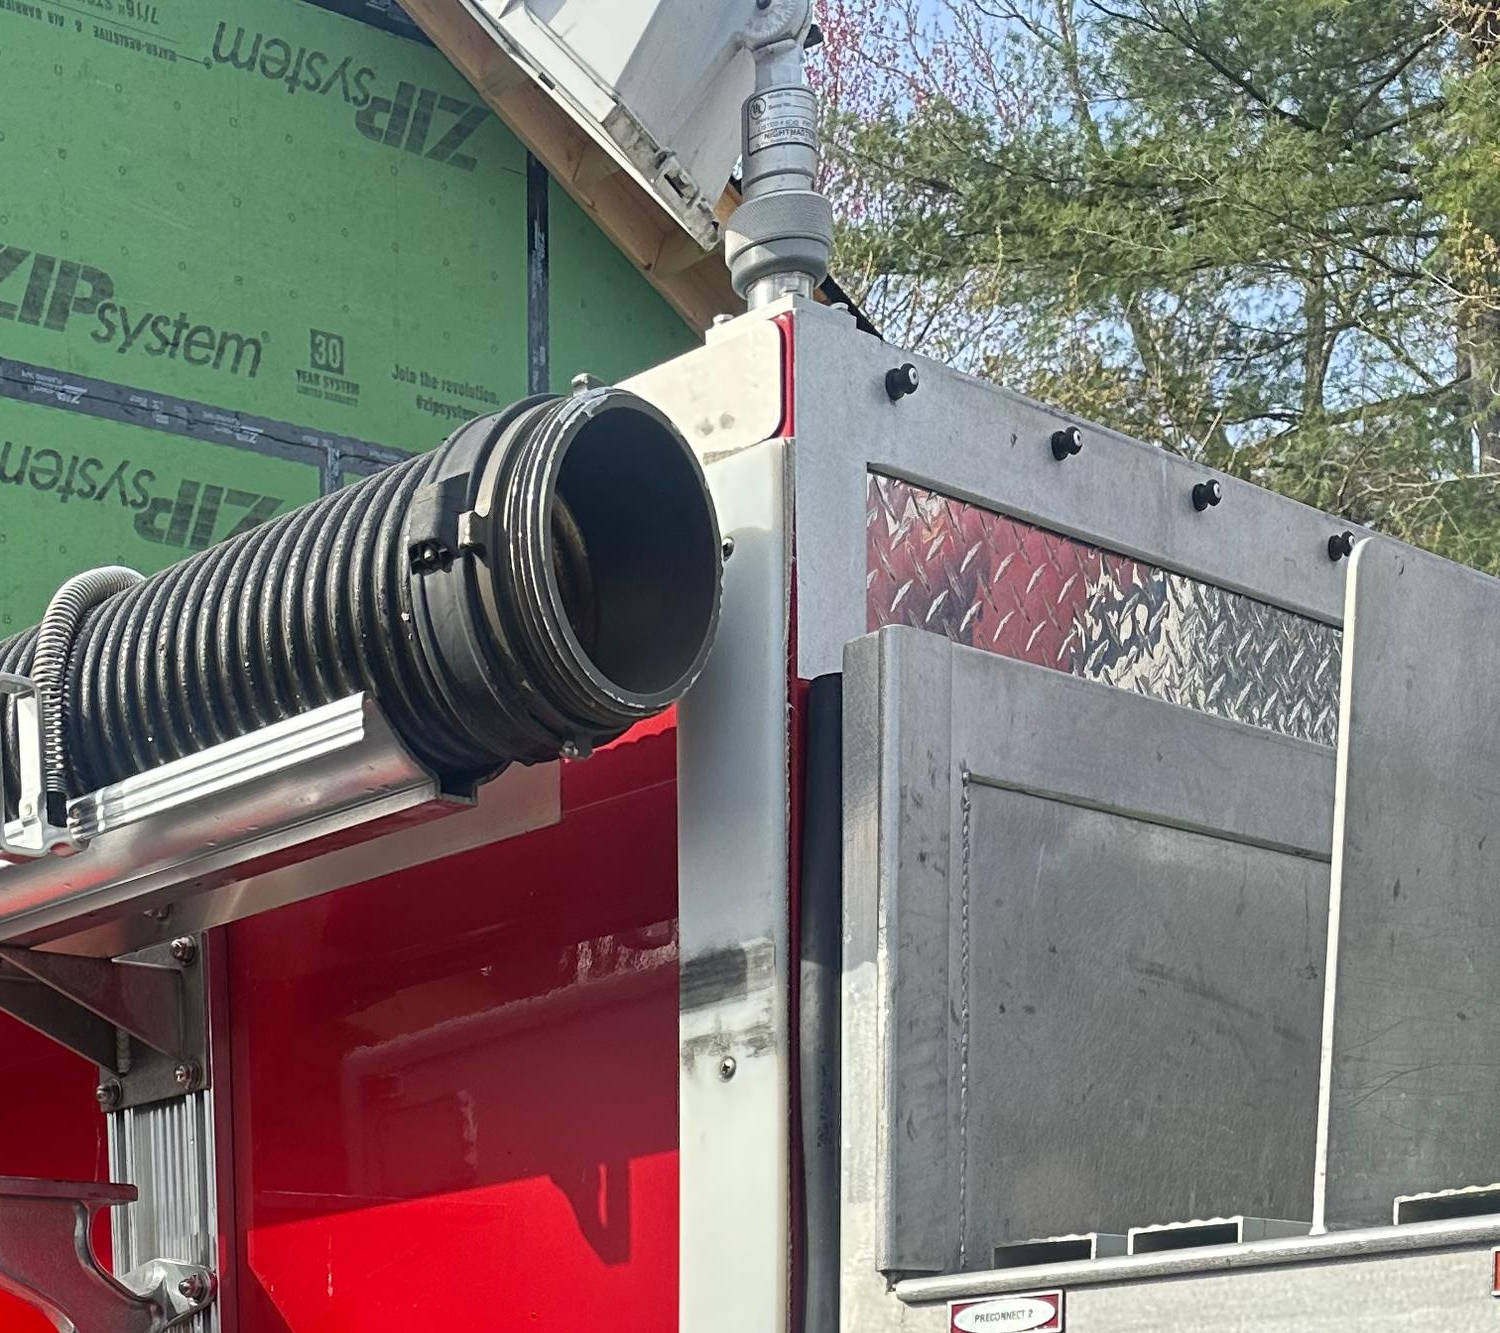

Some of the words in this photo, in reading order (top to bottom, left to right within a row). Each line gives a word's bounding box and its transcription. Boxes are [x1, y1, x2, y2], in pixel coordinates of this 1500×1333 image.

[314, 334, 342, 369] 30
[420, 370, 439, 390] the
[974, 1309, 1025, 1323] PRECONNECT
